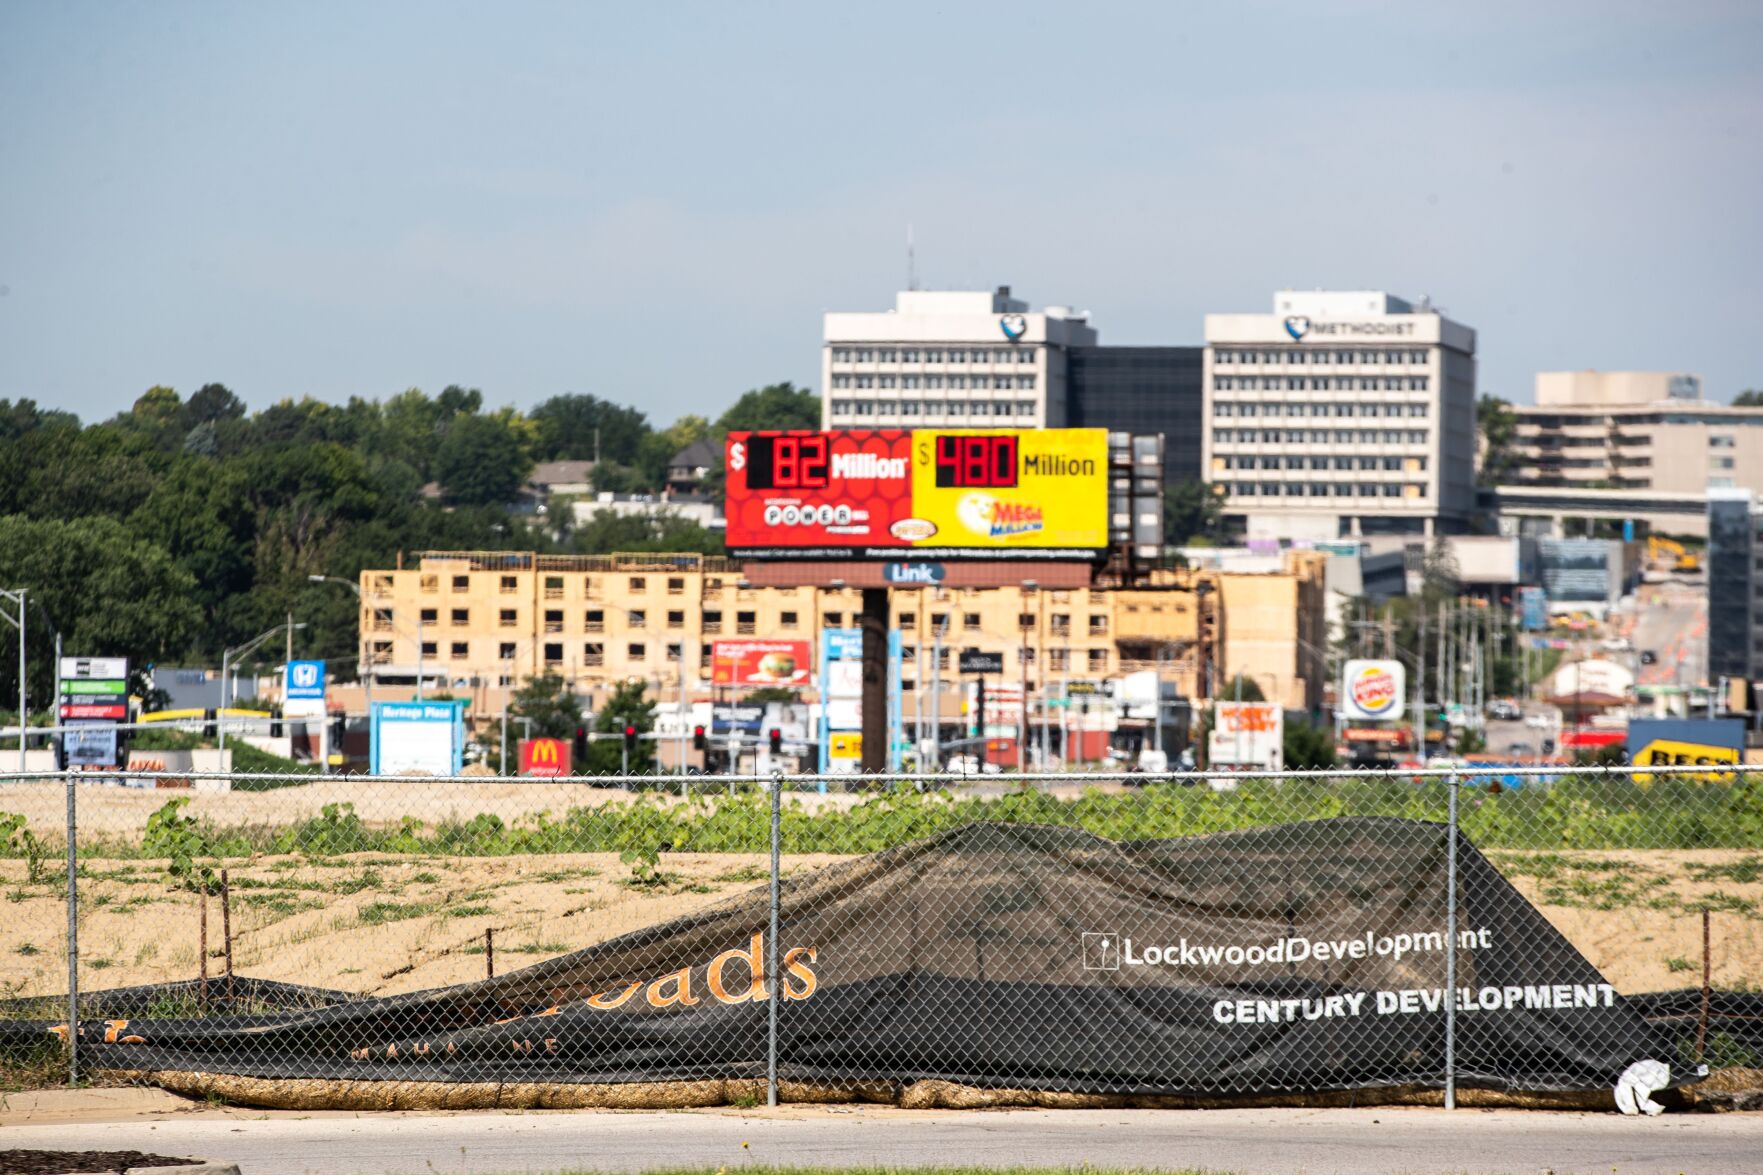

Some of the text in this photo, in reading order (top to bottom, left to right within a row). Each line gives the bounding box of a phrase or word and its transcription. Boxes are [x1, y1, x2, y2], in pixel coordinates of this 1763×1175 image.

[1314, 322, 1415, 335] METHODIST
[730, 437, 908, 487] $ 82 Million
[937, 436, 1016, 486] 480
[1024, 455, 1095, 476] Million
[892, 562, 934, 582] Link
[382, 706, 450, 719] Heritage Plaza
[1212, 984, 1617, 1023] CENTURY DEVELOPMENT
